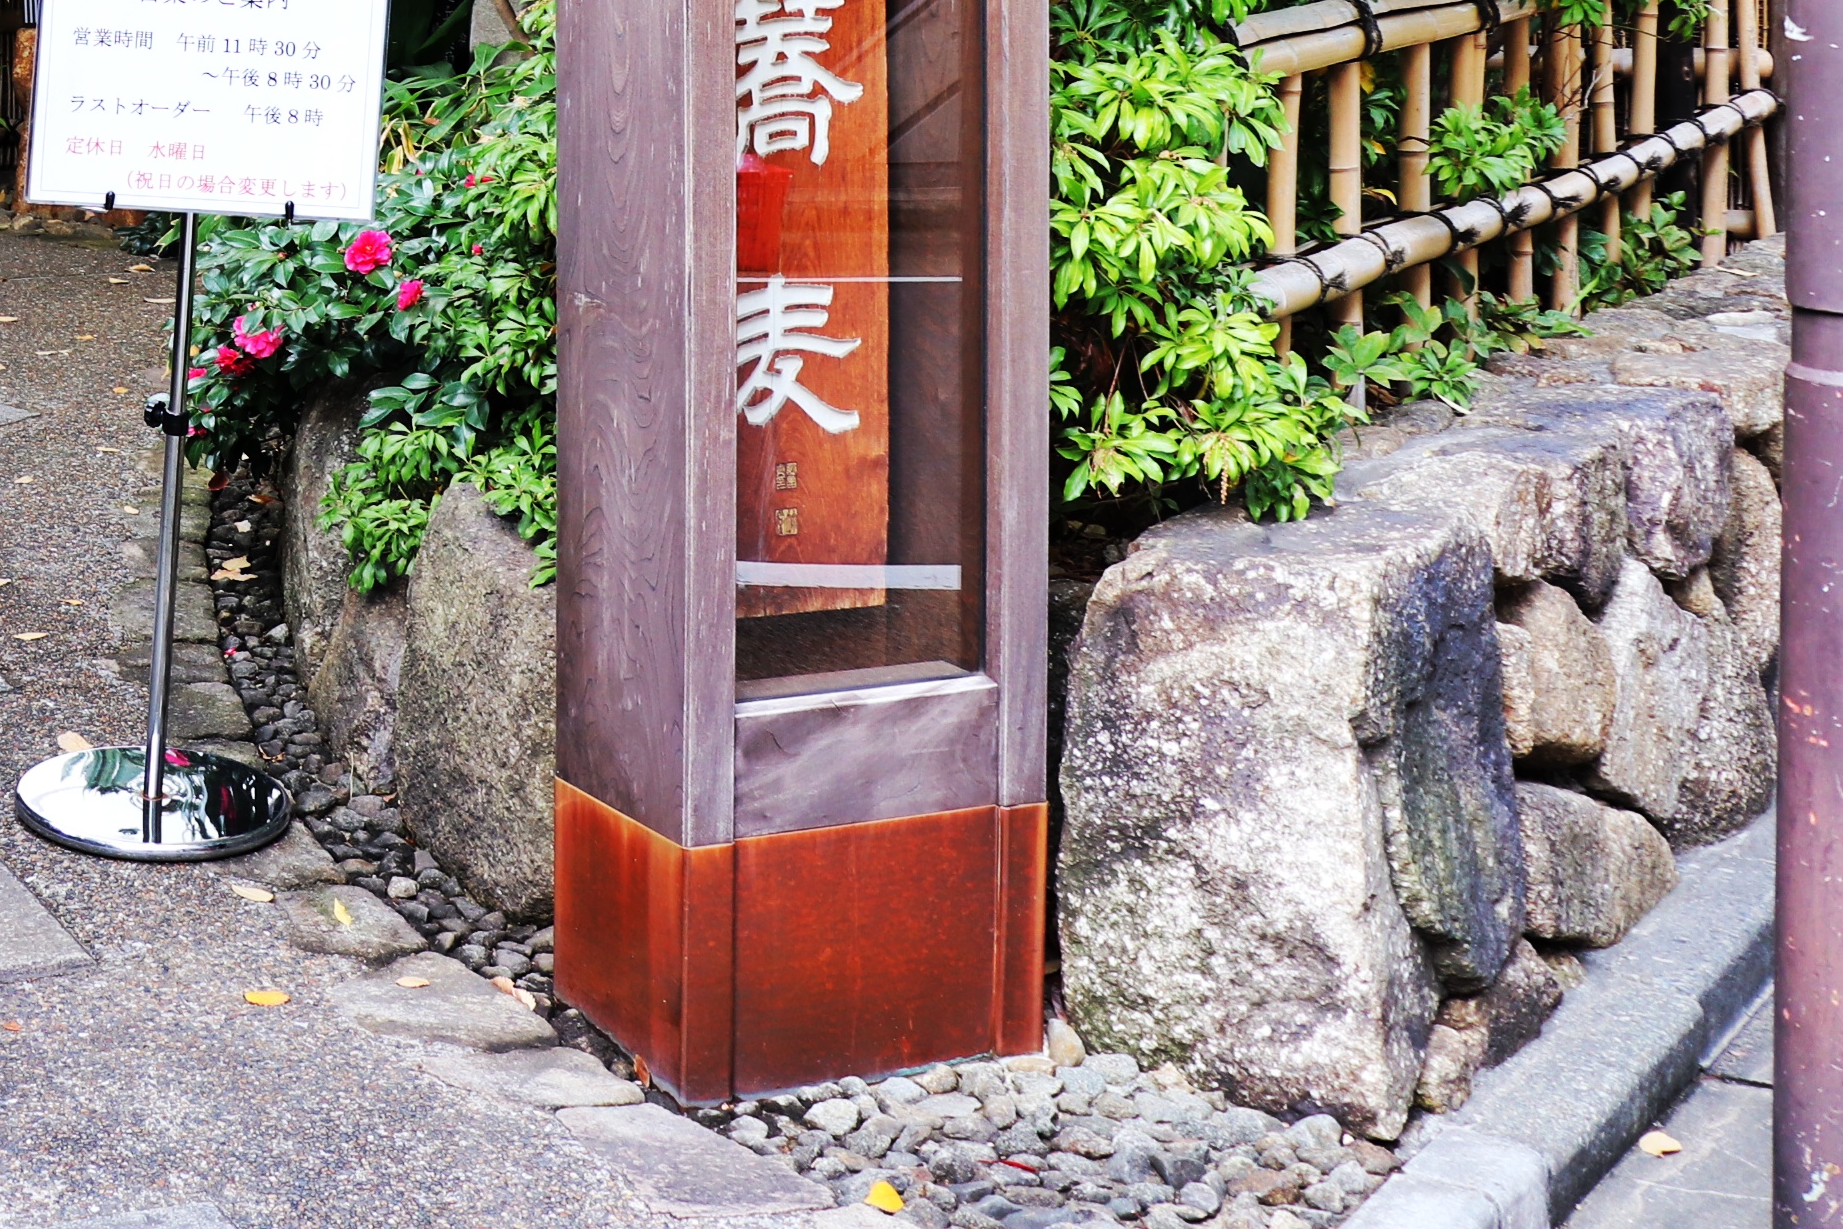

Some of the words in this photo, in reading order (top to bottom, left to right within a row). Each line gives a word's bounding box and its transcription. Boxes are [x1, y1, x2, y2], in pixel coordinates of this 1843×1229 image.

[74, 27, 153, 50] 営業時間
[71, 96, 210, 118] ラストオーダー
[245, 104, 323, 126] 午後8時
[65, 136, 123, 156] 定休日
[147, 140, 205, 160] 水曜日
